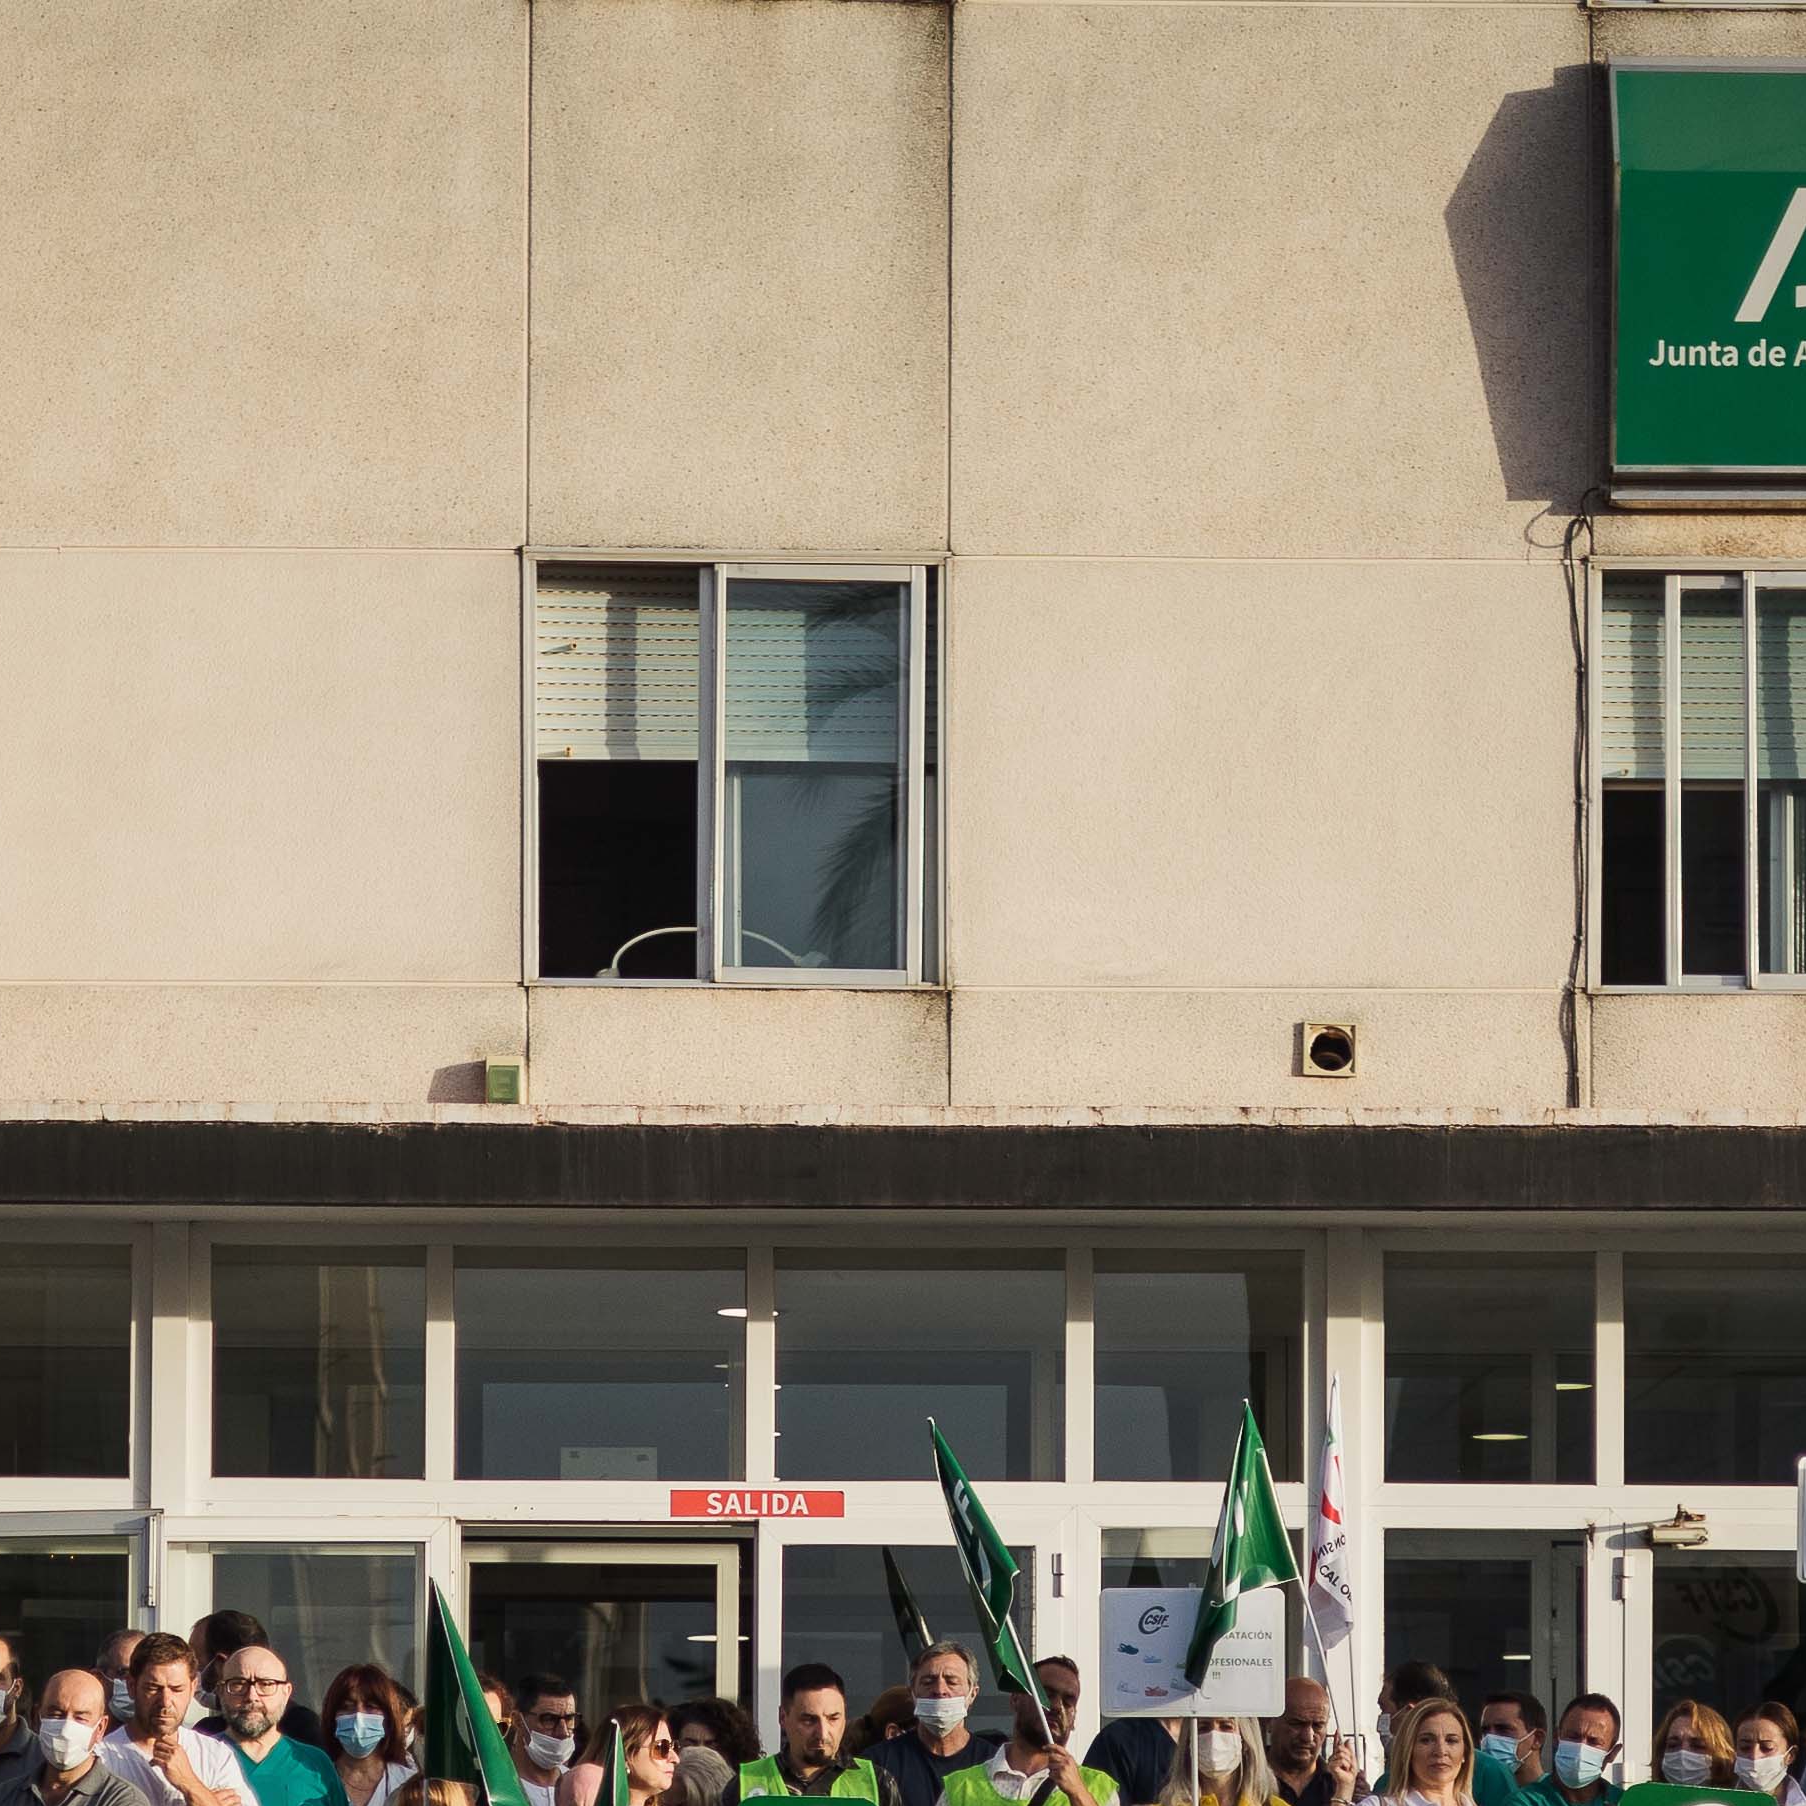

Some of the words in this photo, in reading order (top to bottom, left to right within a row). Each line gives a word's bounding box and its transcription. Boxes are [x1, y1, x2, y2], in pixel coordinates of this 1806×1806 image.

[1649, 339, 1739, 367] Junta
[1748, 338, 1786, 367] de
[706, 1493, 809, 1515] SALIDA
[1224, 1630, 1272, 1640] ATACIÓN
[1210, 1658, 1272, 1666] OFESIONALES
